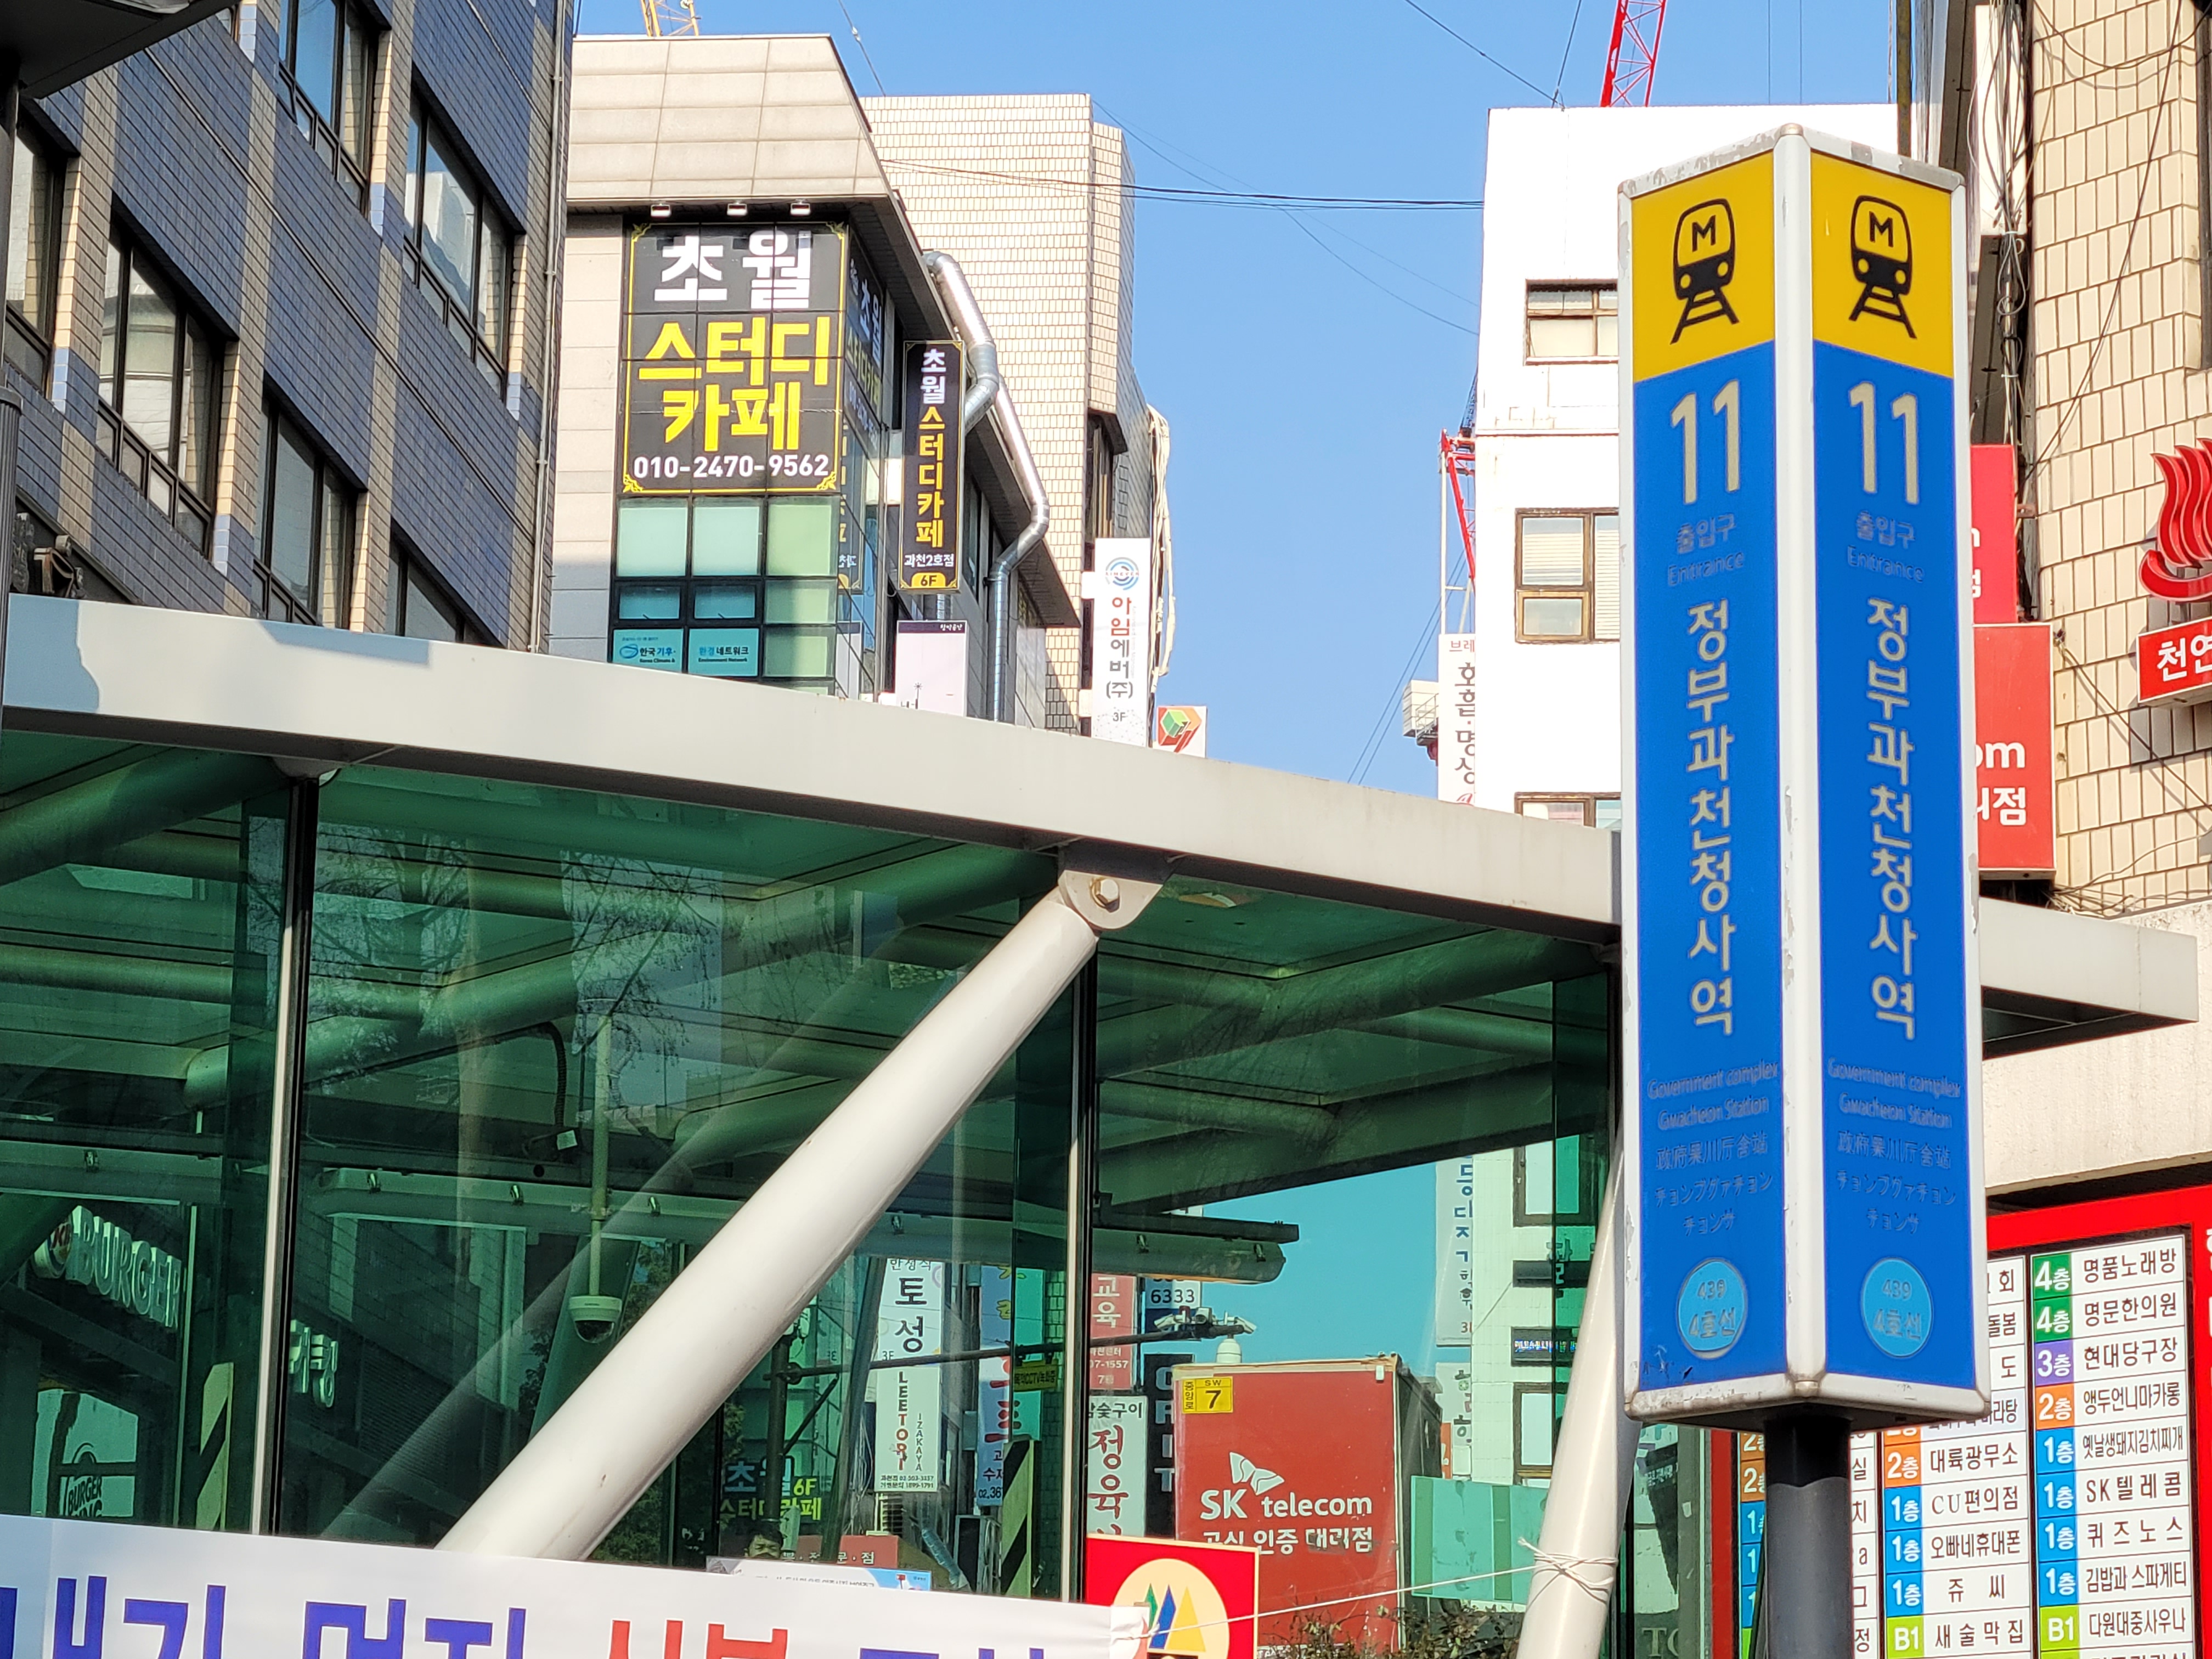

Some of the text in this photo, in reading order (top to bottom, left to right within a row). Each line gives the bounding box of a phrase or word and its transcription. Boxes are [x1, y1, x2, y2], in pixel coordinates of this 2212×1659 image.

[1691, 215, 1716, 252] M
[1869, 211, 1894, 248] M
[654, 229, 812, 309] 초월
[638, 317, 830, 386] 스터디
[920, 348, 946, 404] 초월
[663, 382, 800, 452] 카페
[1671, 379, 1740, 504] 11
[1848, 381, 1920, 504] 11
[633, 454, 829, 479] 010-2470-9562
[917, 406, 946, 549] 스터디카페
[1677, 514, 1736, 554] 출입구
[1855, 511, 1915, 548] 출입구
[904, 554, 954, 567] 과천2호점
[1667, 550, 1745, 586] Entrance
[1848, 545, 1925, 582] Entrance
[921, 575, 937, 586] 6F
[1109, 597, 1132, 679] 아임에버
[1106, 681, 1133, 698] (주)
[1113, 712, 1126, 722] 3F
[1686, 598, 1737, 1036] 정부과천청사역
[1866, 597, 1918, 1040] 정부과천청사역
[1647, 1059, 1778, 1099] Government complex
[1828, 1057, 1960, 1099] Government complex
[1658, 1094, 1769, 1131] Gwacheon Station
[1839, 1093, 1952, 1129] Gwacheon Station
[65, 1205, 182, 1330] BURGER
[2035, 1248, 2177, 1291] 4층 명품노래방
[1092, 1276, 1121, 1328] 교육
[1150, 1289, 1195, 1304] 6333
[1697, 1279, 1726, 1300] 439
[1882, 1279, 1912, 1300] 439
[895, 1278, 927, 1352] 토성
[1688, 1307, 1735, 1339] 4호선
[1874, 1308, 1921, 1340] 4호선
[2036, 1293, 2177, 1333] 4층 명문한의원
[2038, 1337, 2178, 1377] 3층 현대당구장
[1205, 1390, 1222, 1409] 7
[2039, 1382, 2180, 1421] 2층 앵두언니마카롱
[2044, 1425, 2183, 1464] 1층 옛날생돼지김치찌개
[1088, 1425, 1129, 1535] 정육
[1887, 1452, 1919, 1479] 2층
[793, 1478, 817, 1496] 6F
[1200, 1488, 1373, 1521] SK telecom
[2044, 1481, 2074, 1509] 1층
[1891, 1496, 1920, 1522] 1층
[1253, 1528, 1299, 1555] 인증
[1305, 1527, 1372, 1553] 대리점
[1892, 1530, 2021, 1562] 1층 오빠네휴대폰
[2044, 1522, 2075, 1550] 1층
[1893, 1579, 1921, 1606] 1층
[2046, 1561, 2187, 1595] 1층 김밥과 스파게티
[1894, 1626, 1918, 1651] B1
[2047, 1607, 2186, 1641] B1 다원대중사우나
